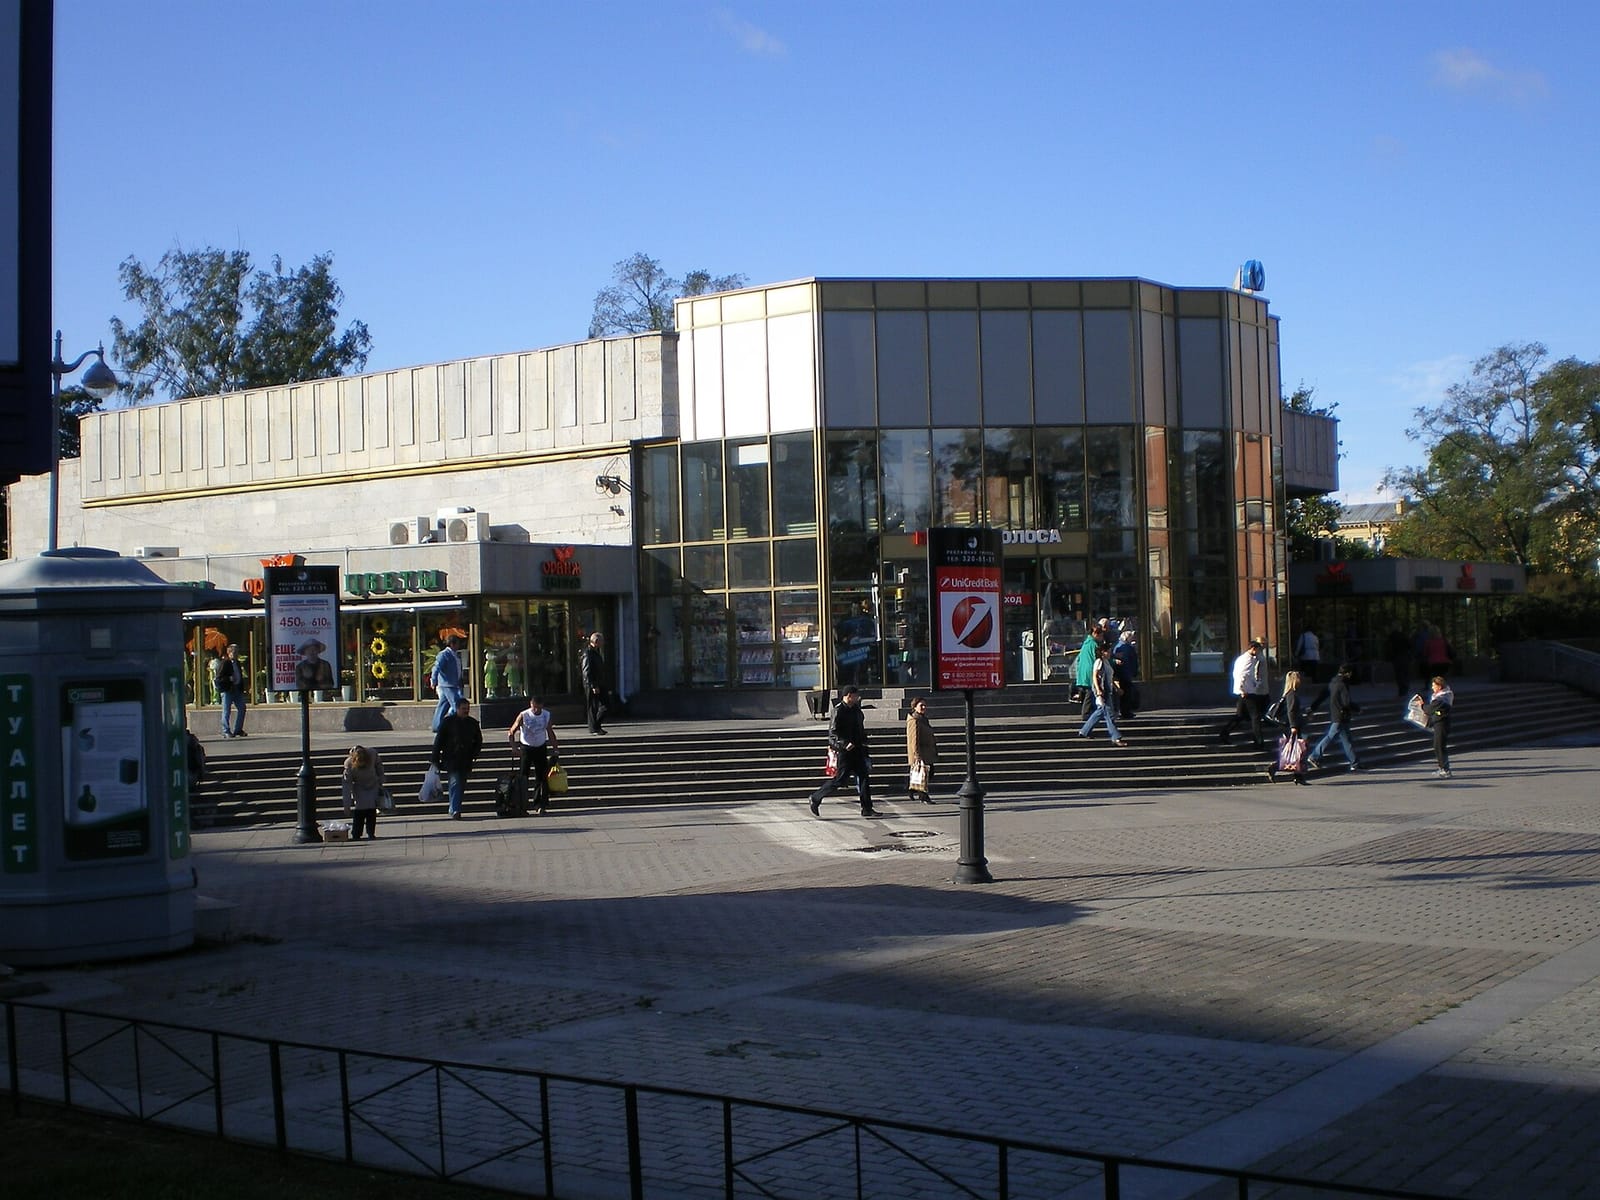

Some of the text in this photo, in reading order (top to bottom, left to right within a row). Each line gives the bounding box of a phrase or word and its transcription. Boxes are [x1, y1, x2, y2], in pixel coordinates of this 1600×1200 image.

[1002, 530, 1062, 544] ОЛОСА
[345, 570, 446, 597] ЦВЕТЫ
[1003, 596, 1023, 605] ход
[8, 685, 29, 863] ТУАЛЕТ
[169, 677, 184, 849] ТУАЛЕТ
